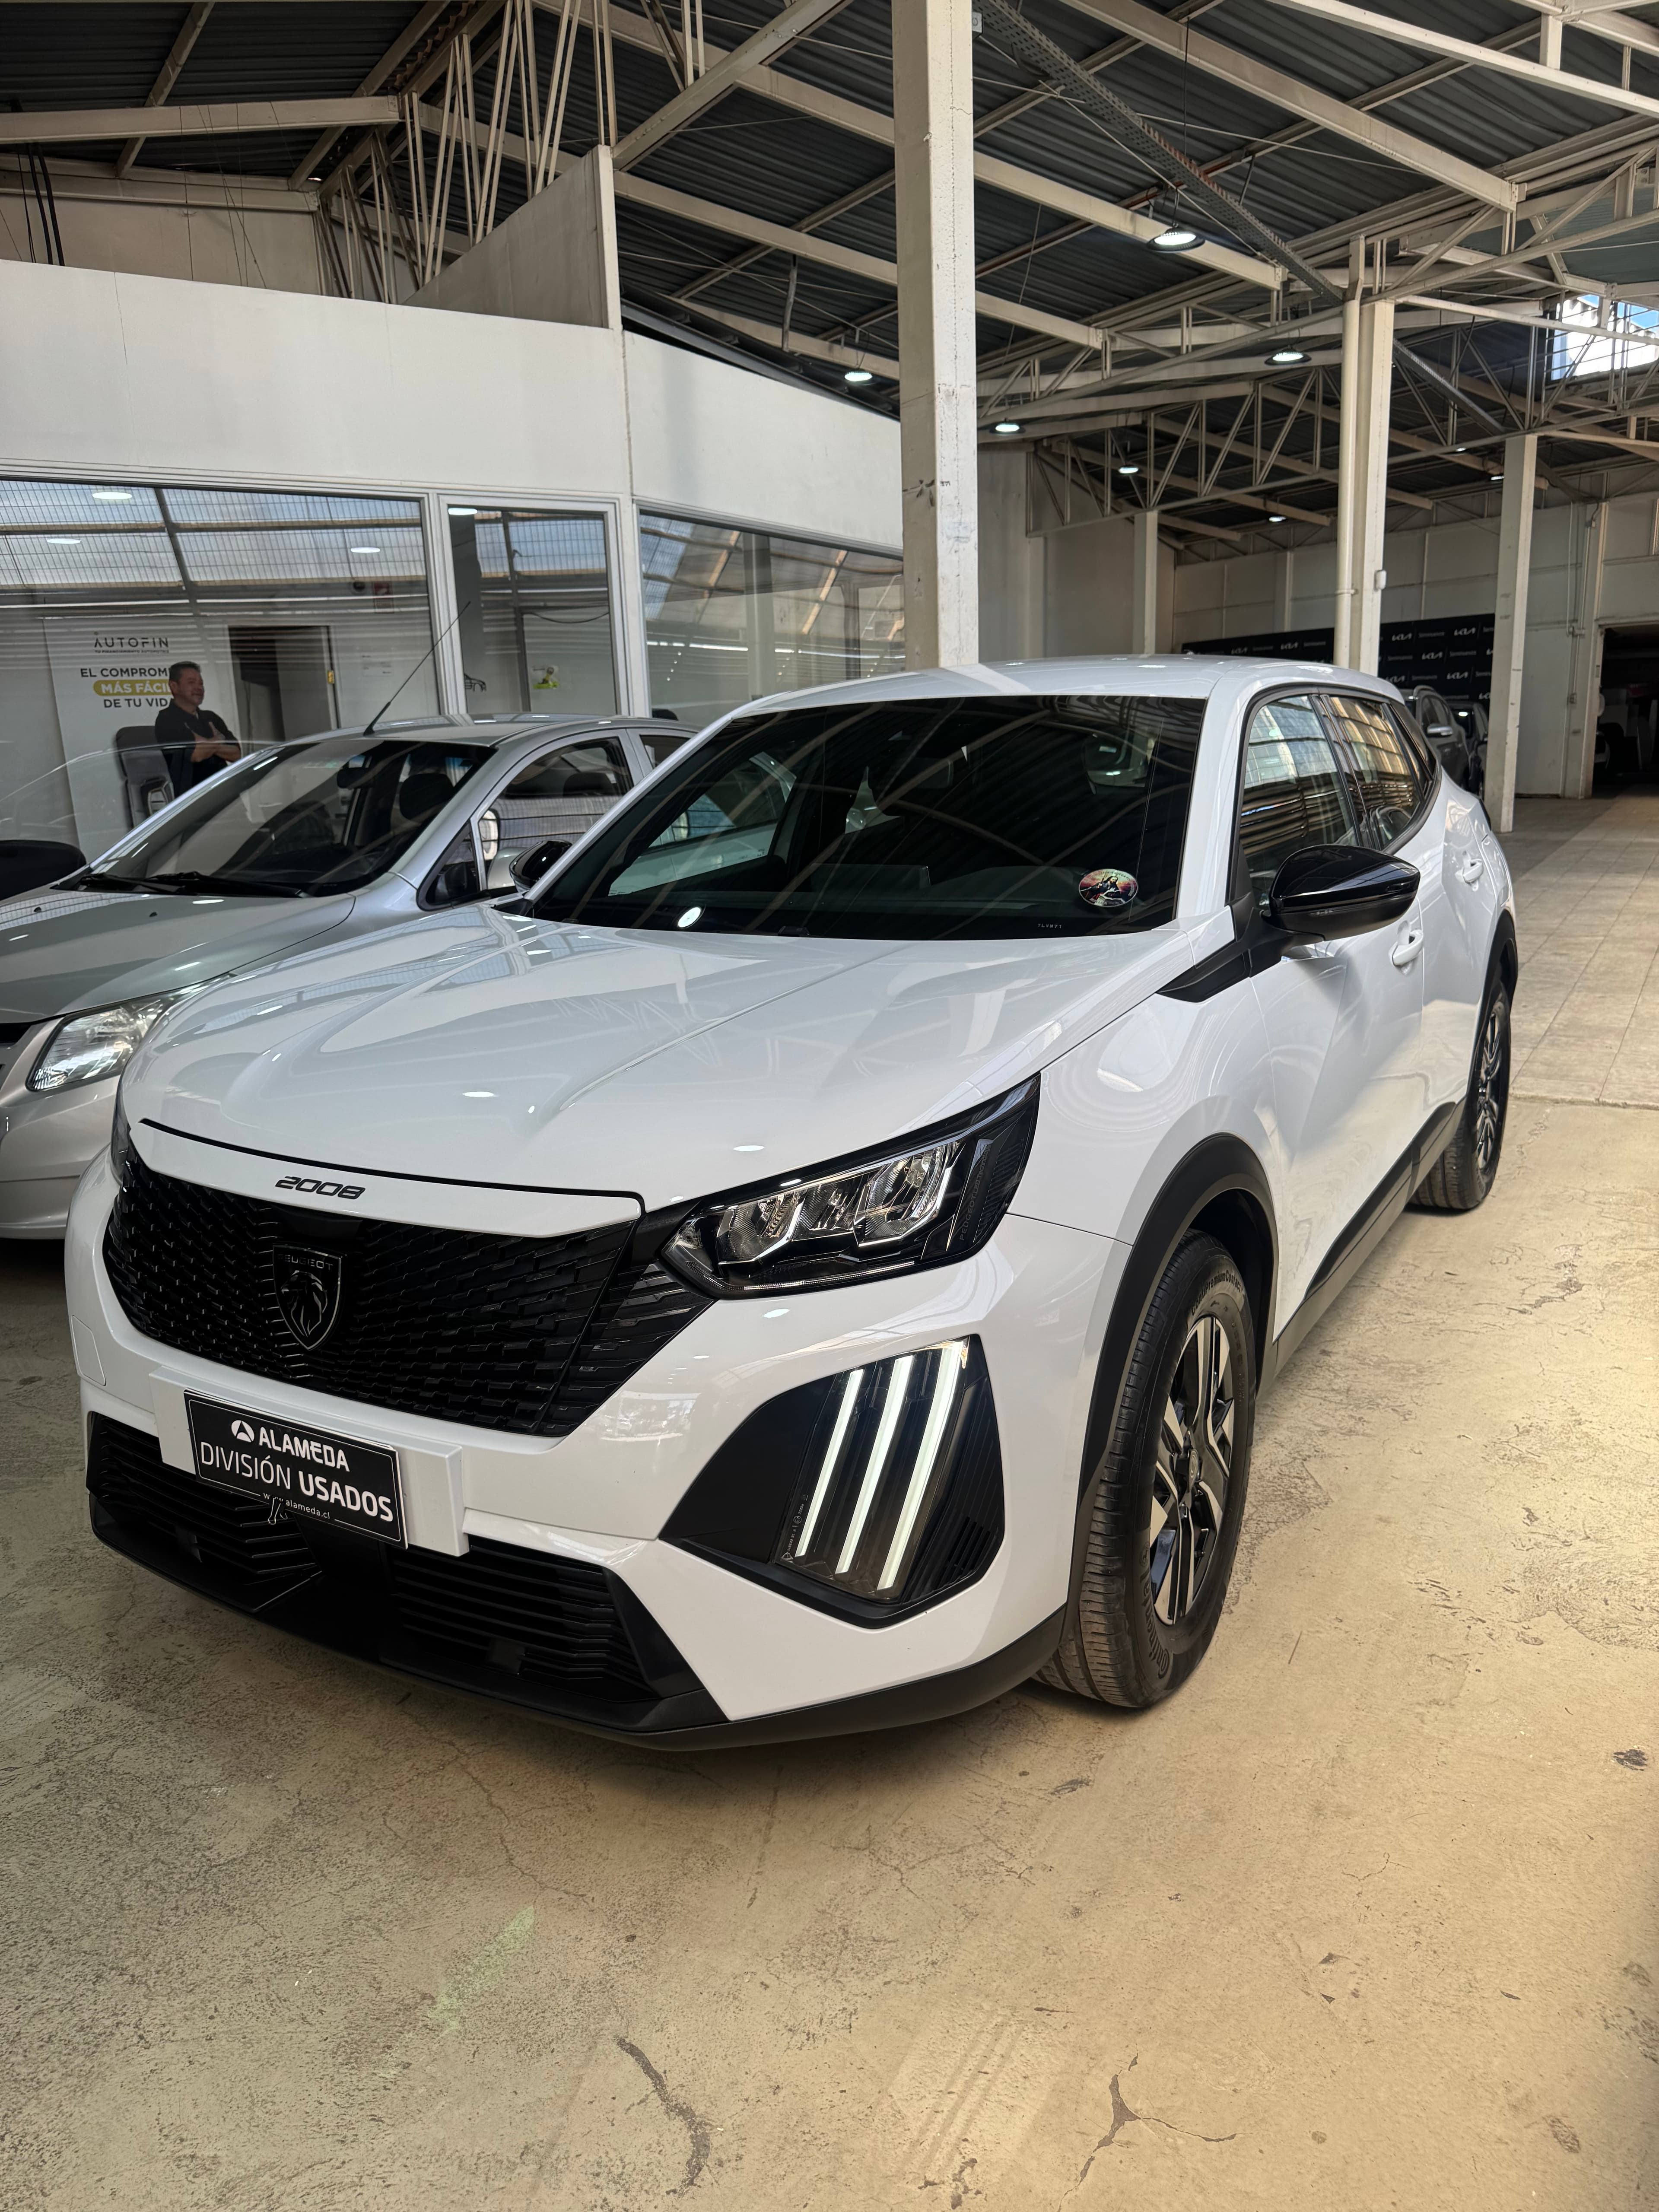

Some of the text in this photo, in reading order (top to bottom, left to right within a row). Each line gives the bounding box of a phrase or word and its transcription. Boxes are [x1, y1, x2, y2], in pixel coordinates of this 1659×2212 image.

[94, 637, 169, 648] AUTOFIN
[80, 668, 97, 677] EL
[101, 681, 131, 693] MÁS
[104, 699, 121, 708] DE
[125, 699, 142, 707] TU
[977, 1144, 991, 1178] Technology
[275, 1176, 365, 1200] 2008
[276, 1254, 333, 1271] PEUGEOT
[259, 1427, 350, 1472] ALAMEDA
[201, 1441, 394, 1522] DIVISIÓN USADOS
